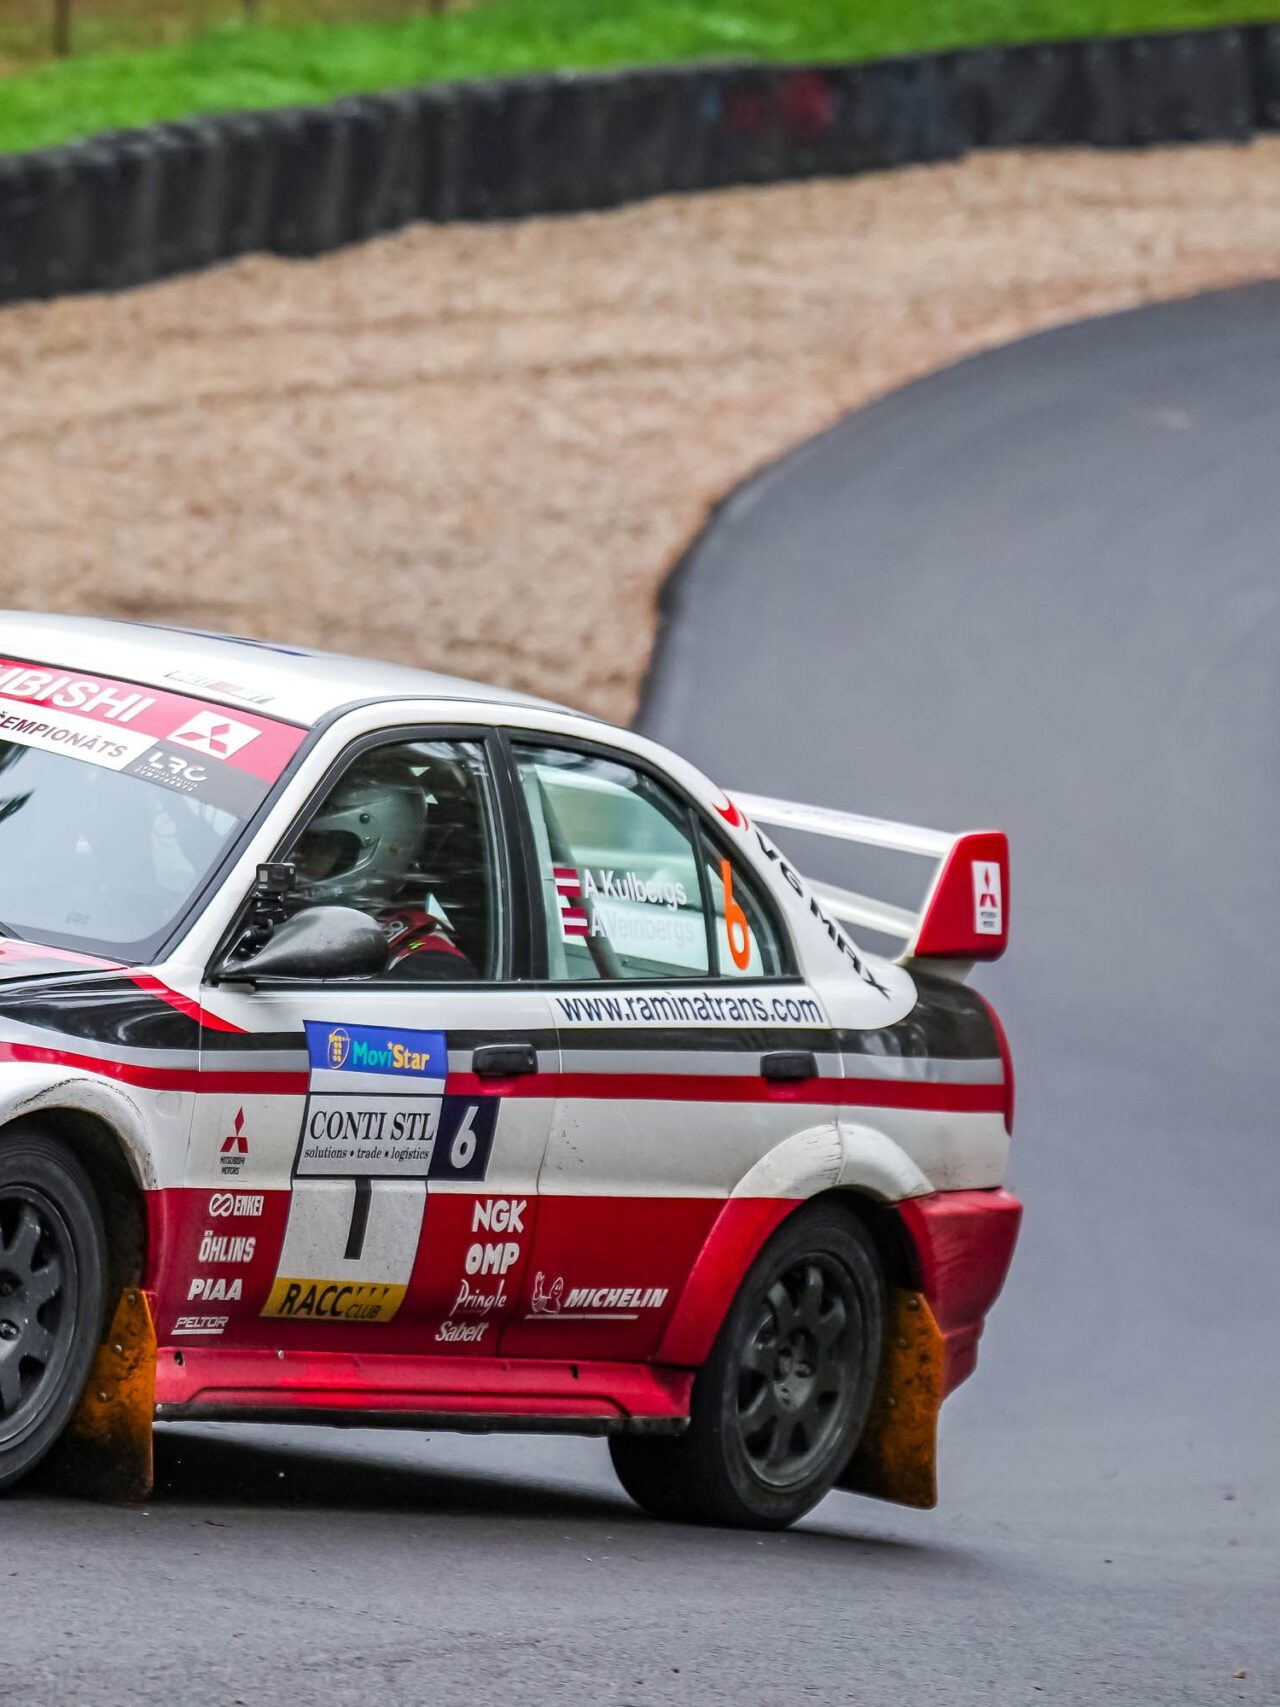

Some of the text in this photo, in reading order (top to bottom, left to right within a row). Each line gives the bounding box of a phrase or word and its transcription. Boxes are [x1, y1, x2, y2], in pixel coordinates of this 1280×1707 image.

[584, 868, 688, 911] A.Kulbergs
[721, 859, 751, 971] 6
[555, 992, 825, 1023] www.raminatrans.com
[310, 1111, 435, 1141] CONTI STL
[449, 1106, 479, 1169] 6
[304, 1146, 429, 1162] solutions trade logistics
[233, 1195, 264, 1216] ENKEI
[471, 1199, 527, 1233] NGK
[198, 1230, 256, 1263] ÖHLINS
[465, 1242, 520, 1275] OMP
[187, 1278, 243, 1301] PIAA
[449, 1279, 507, 1317] Pringle
[563, 1288, 669, 1308] MICHELIN
[175, 1316, 229, 1329] PELTOR
[345, 1303, 382, 1319] CLUB
